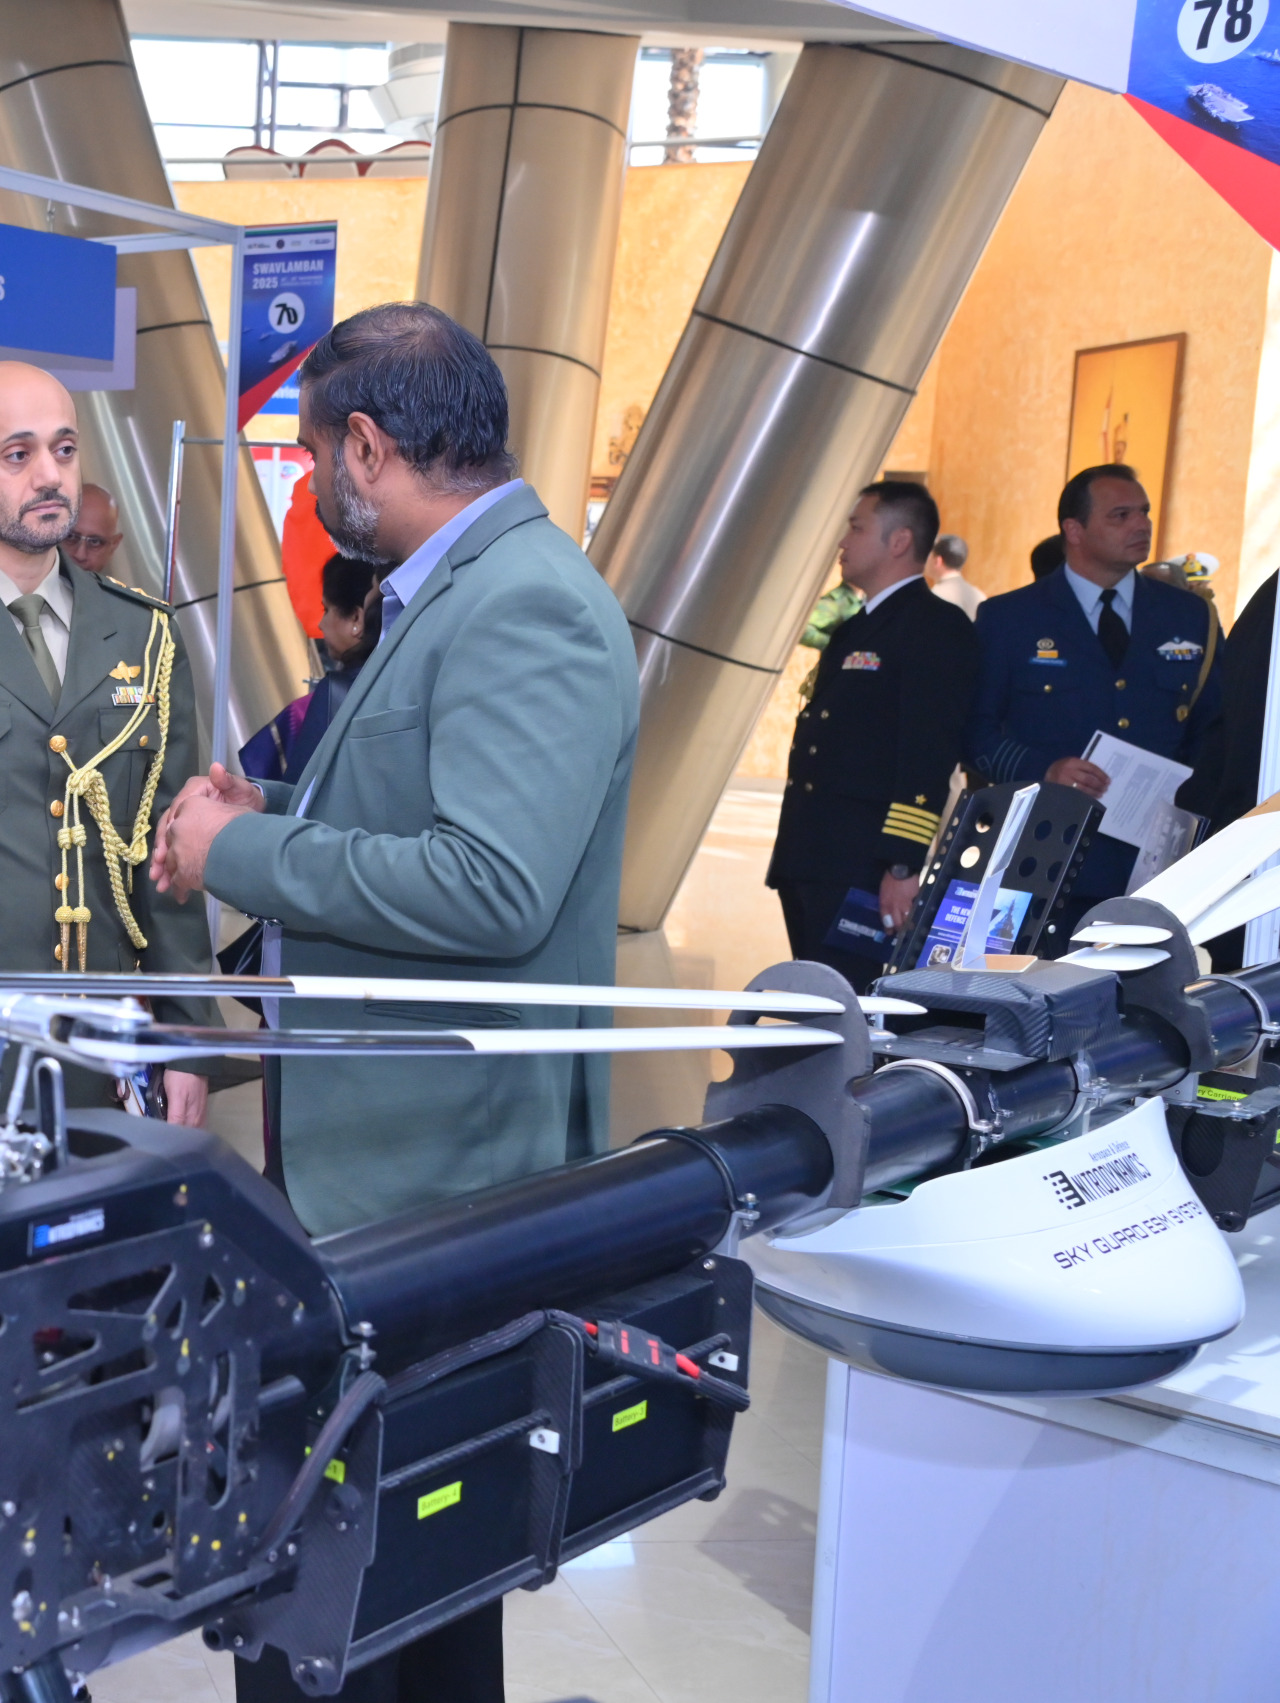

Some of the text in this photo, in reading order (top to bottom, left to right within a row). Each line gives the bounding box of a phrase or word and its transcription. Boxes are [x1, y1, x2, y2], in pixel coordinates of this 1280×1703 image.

[1193, 0, 1254, 50] 78
[252, 258, 324, 276] SWAVLAMBAN
[252, 276, 279, 290] 2025
[274, 302, 299, 327] 70
[1053, 1242, 1094, 1270] SKY
[1092, 1223, 1150, 1254] GUARD
[1142, 1212, 1177, 1235] ESM
